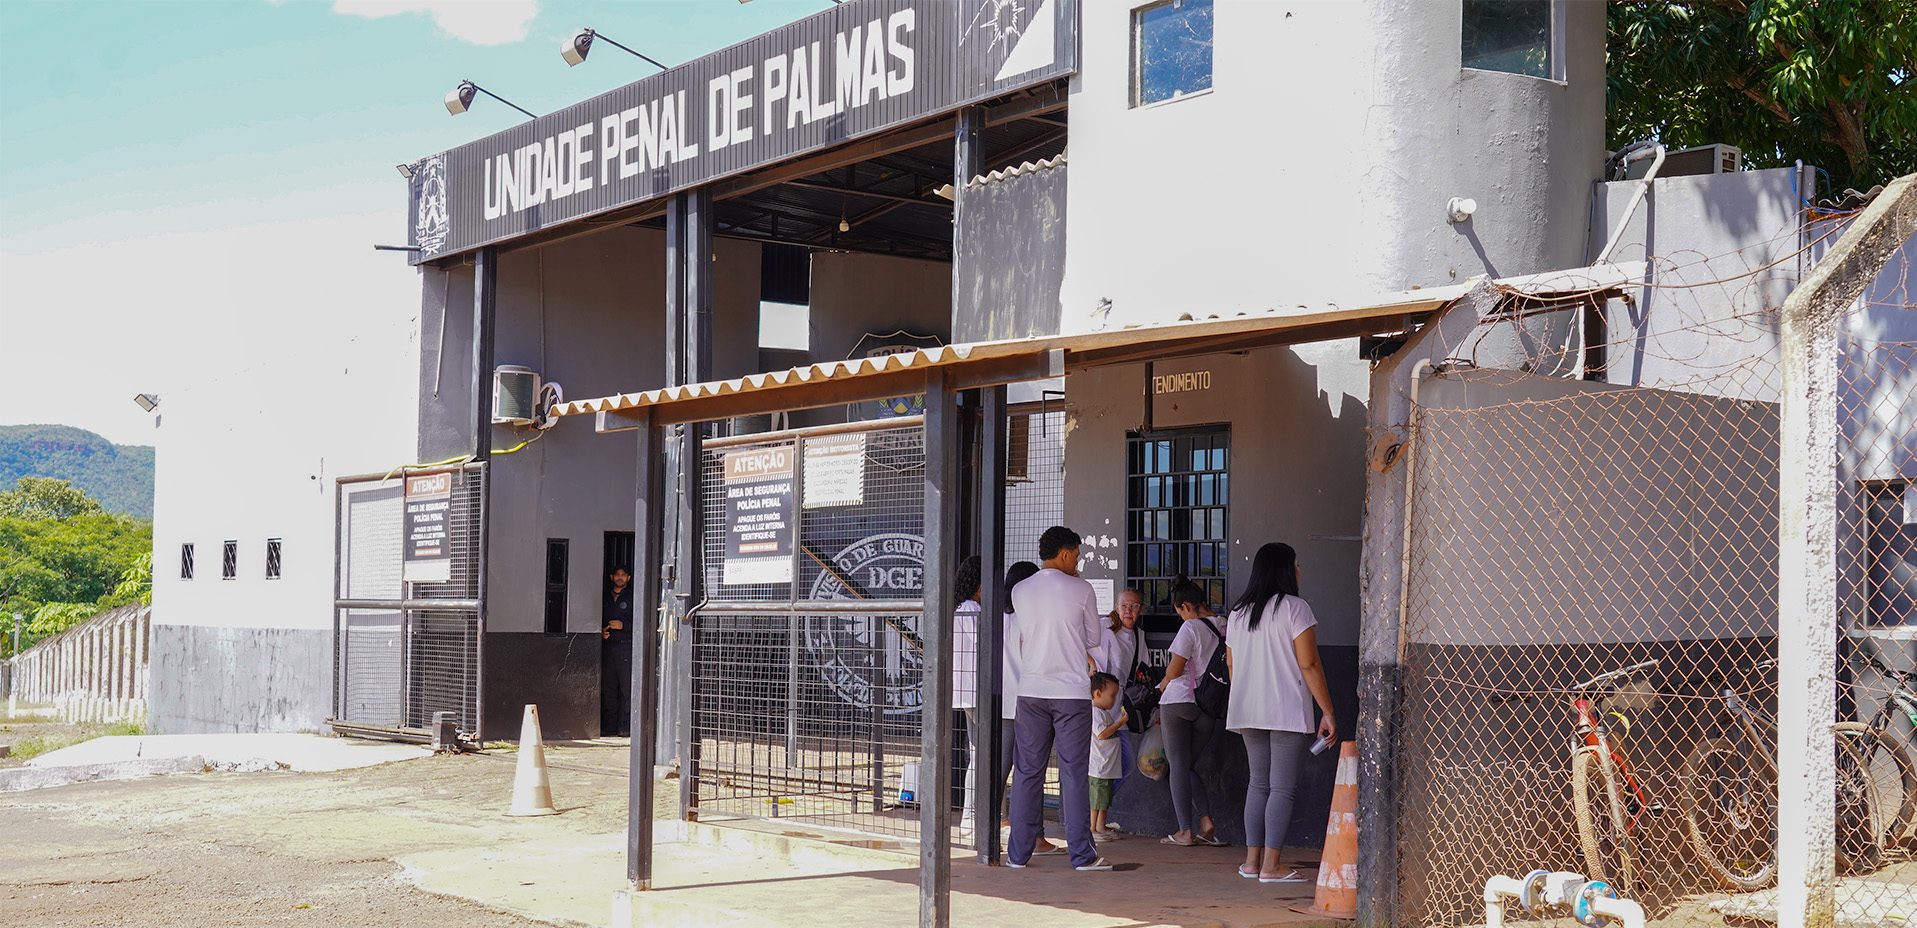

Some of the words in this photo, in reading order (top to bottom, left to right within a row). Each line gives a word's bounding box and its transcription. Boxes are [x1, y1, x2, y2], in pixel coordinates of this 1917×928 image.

[484, 122, 593, 220] UNIDADE
[601, 90, 699, 187] PENAL
[709, 65, 753, 152] DE
[763, 7, 915, 136] PALMAS
[1143, 370, 1211, 395] TENDIMENTO
[733, 449, 785, 474] ATENÇÃO
[412, 476, 445, 495] ATENÇÃO
[728, 486, 744, 498] ÁREA
[744, 488, 753, 496] DE
[754, 483, 791, 498] SEGURANÇA
[736, 498, 761, 510] POLÍCIA
[762, 498, 781, 508] PENAL
[732, 524, 751, 532] ACENDA
[756, 524, 764, 532] LUZ
[764, 522, 785, 530] INTERNA
[738, 514, 756, 524] APAGUE
[742, 532, 776, 540] IDENTIFIQUE-SE
[852, 543, 878, 563] DE
